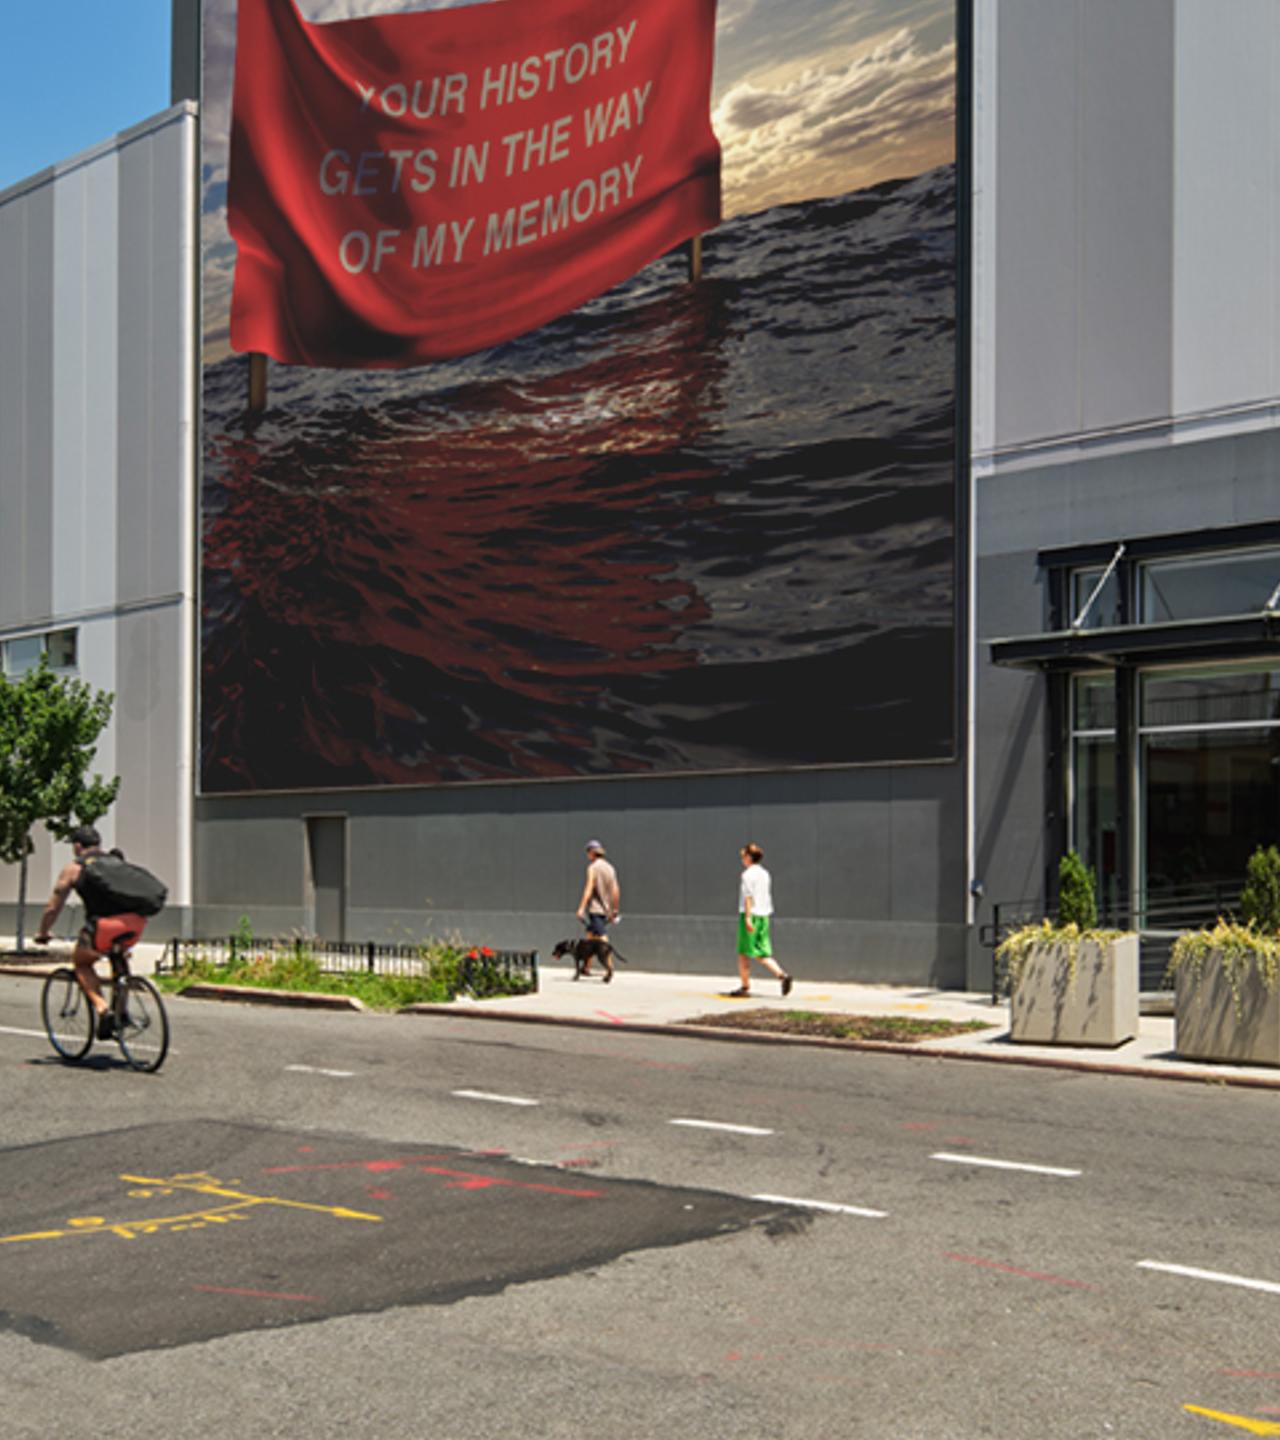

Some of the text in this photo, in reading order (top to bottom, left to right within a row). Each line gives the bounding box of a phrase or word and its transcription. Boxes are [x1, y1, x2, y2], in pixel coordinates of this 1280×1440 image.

[355, 19, 638, 119] YOUR HISTORY
[319, 80, 652, 196] GETS IN THE WAY
[338, 154, 644, 274] OF MY MEMORY
